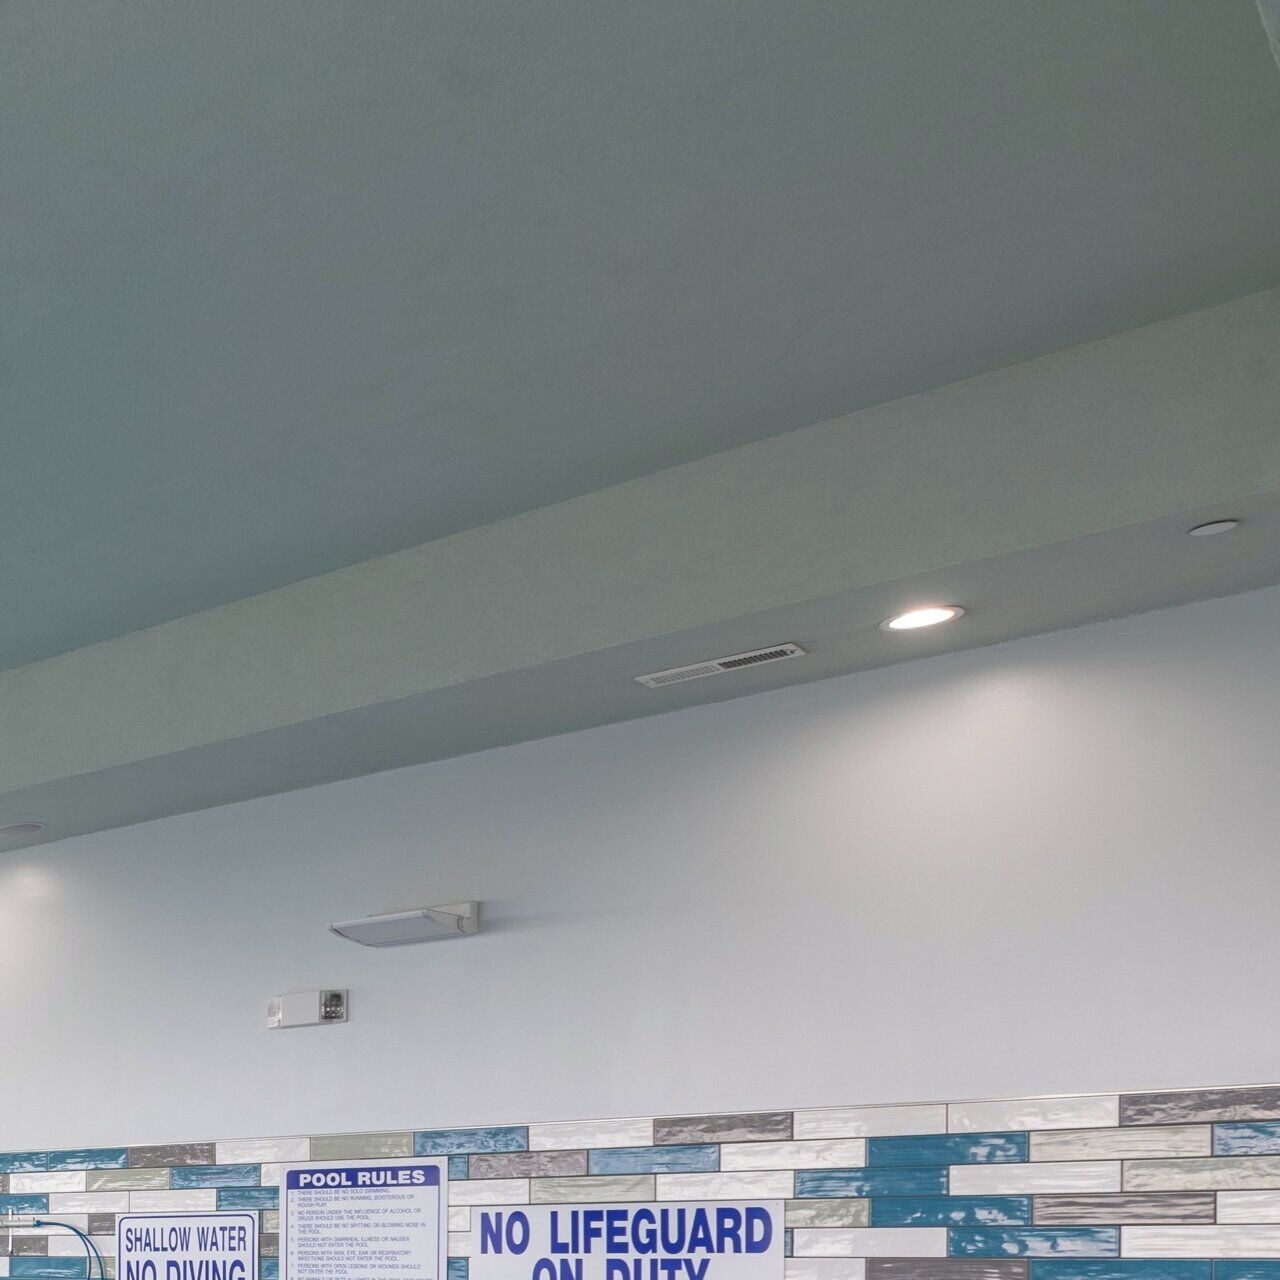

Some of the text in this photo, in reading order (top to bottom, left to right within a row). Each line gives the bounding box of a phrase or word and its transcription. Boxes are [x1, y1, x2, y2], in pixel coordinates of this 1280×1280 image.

[299, 1169, 425, 1188] POOL RULES
[125, 1226, 247, 1252] SHALLOW WATER
[480, 1207, 772, 1255] NO LIFEGUARD
